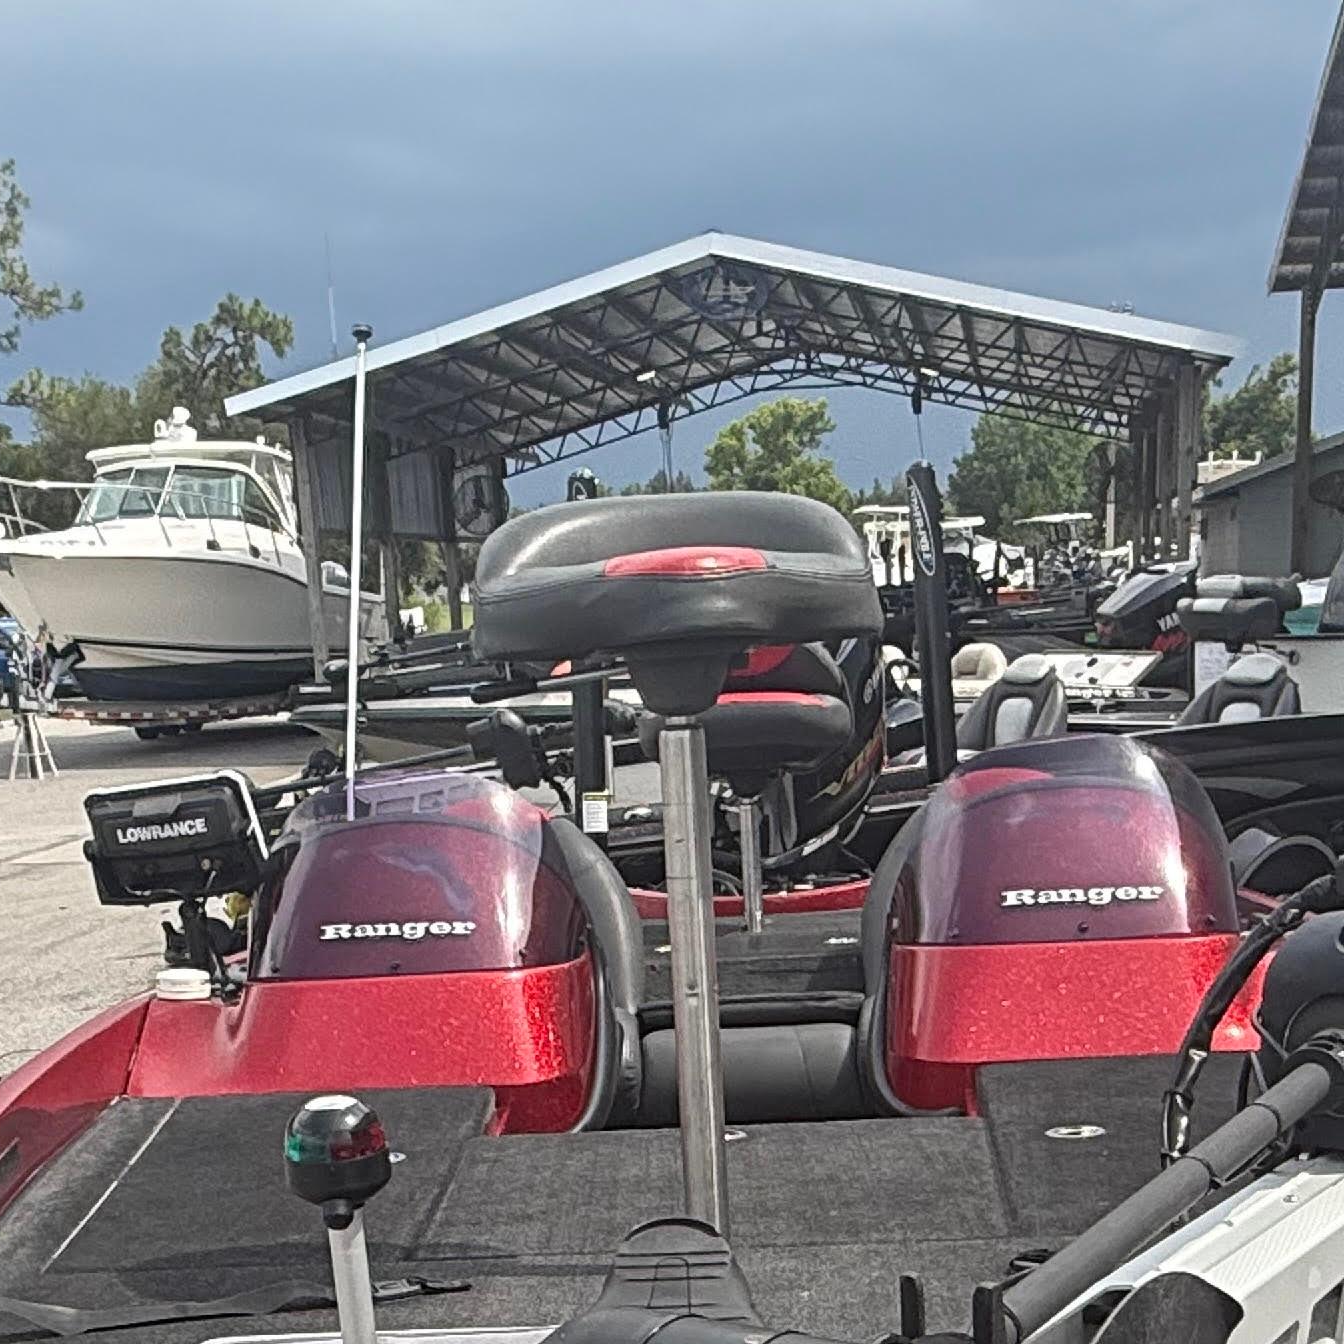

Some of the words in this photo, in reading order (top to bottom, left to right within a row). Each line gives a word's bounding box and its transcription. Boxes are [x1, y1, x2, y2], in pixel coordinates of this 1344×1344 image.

[116, 817, 208, 844] LOWRANCE
[1000, 886, 1165, 907] Ranger
[319, 921, 477, 940] Ranger
